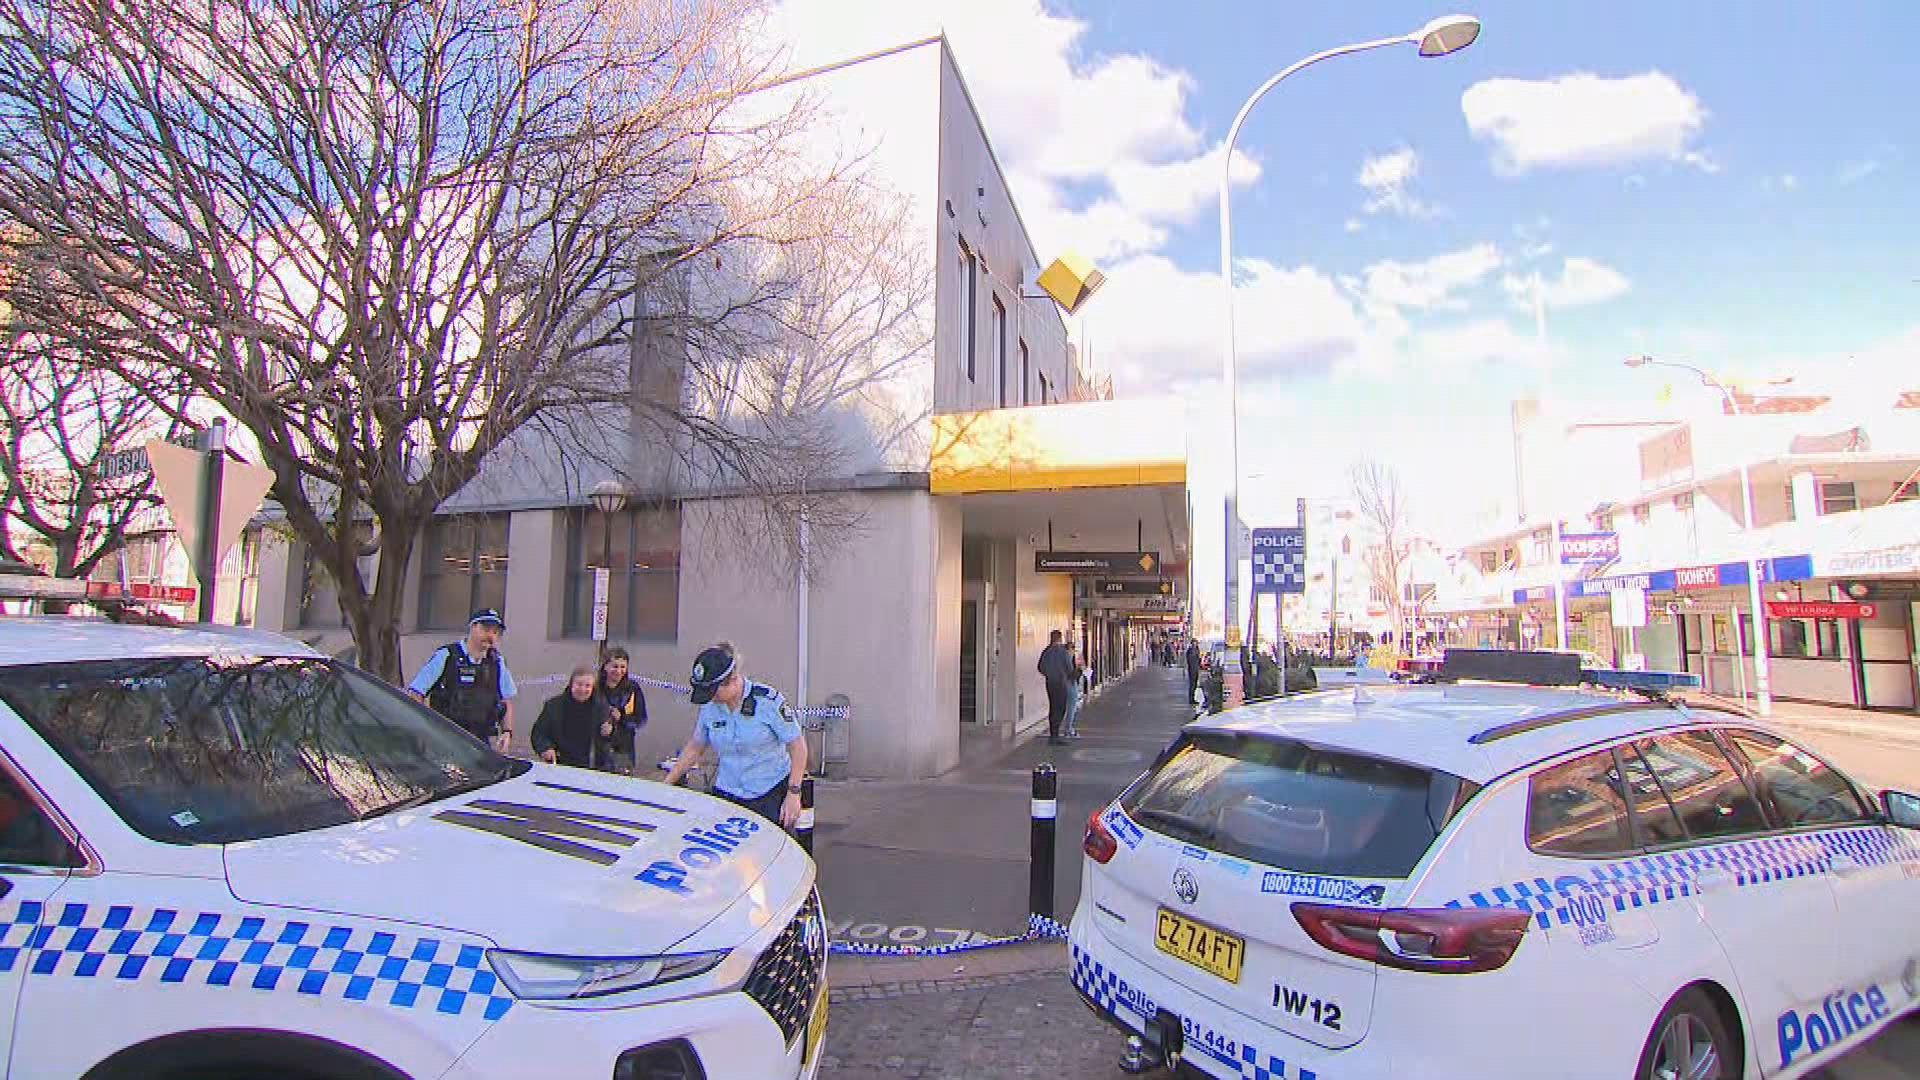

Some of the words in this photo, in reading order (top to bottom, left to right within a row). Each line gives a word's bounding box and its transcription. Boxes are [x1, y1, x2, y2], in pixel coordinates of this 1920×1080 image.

[108, 447, 148, 477] DESPO
[1253, 535, 1304, 547] POLICE
[1106, 583, 1123, 591] ATM
[1677, 567, 1716, 585] TOOHEYS
[1800, 606, 1836, 614] LOUNGE
[633, 816, 760, 896] Police
[1264, 872, 1290, 893] 1800
[1291, 875, 1316, 895] 333
[1318, 878, 1344, 898] 000
[1567, 893, 1607, 928] 000
[1158, 915, 1181, 947] CZ
[1186, 925, 1207, 959] 74
[1212, 935, 1238, 970] FT
[1118, 980, 1156, 1014] Polic
[1204, 1029, 1236, 1058] 444
[1272, 983, 1342, 1031] IW12
[1776, 983, 1891, 1070] Police
